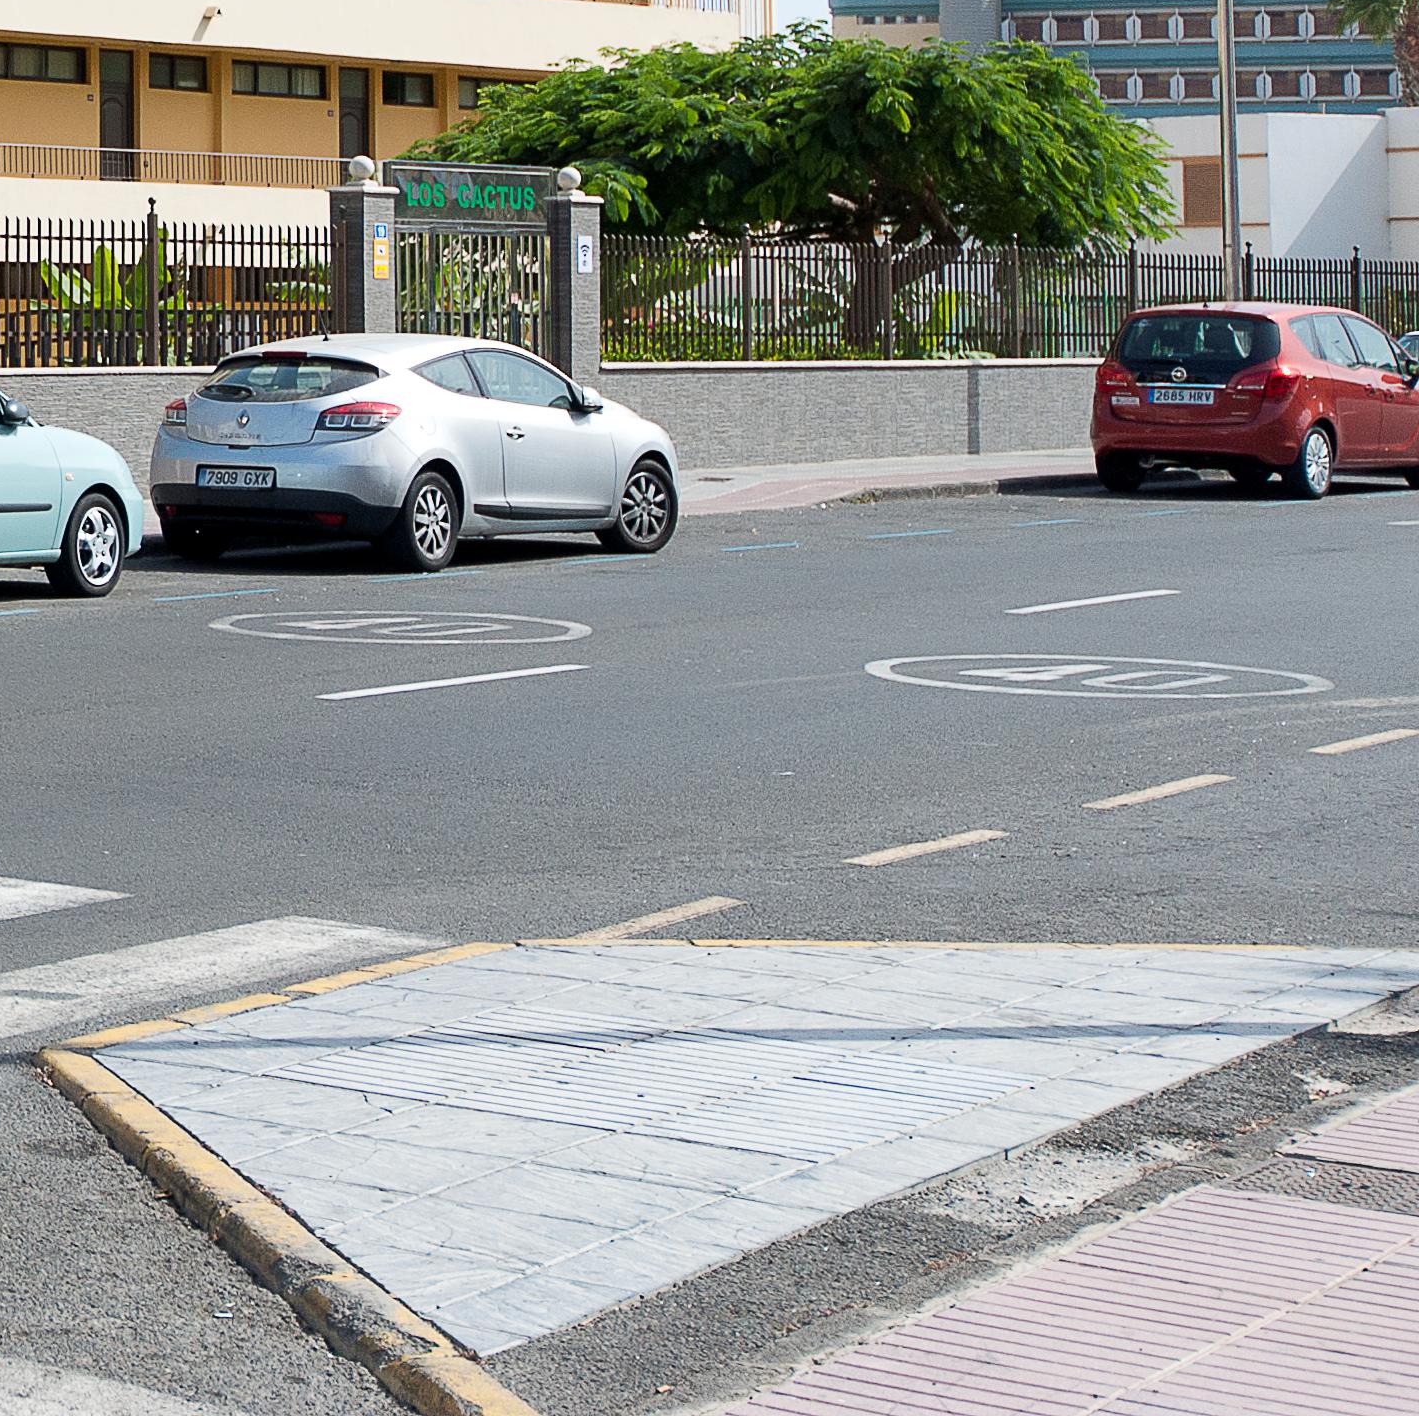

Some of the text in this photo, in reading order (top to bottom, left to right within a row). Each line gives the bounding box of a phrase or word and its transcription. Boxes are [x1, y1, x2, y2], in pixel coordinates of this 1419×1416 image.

[406, 181, 537, 211] LOS CACTUS
[206, 470, 271, 486] 7909 GXK
